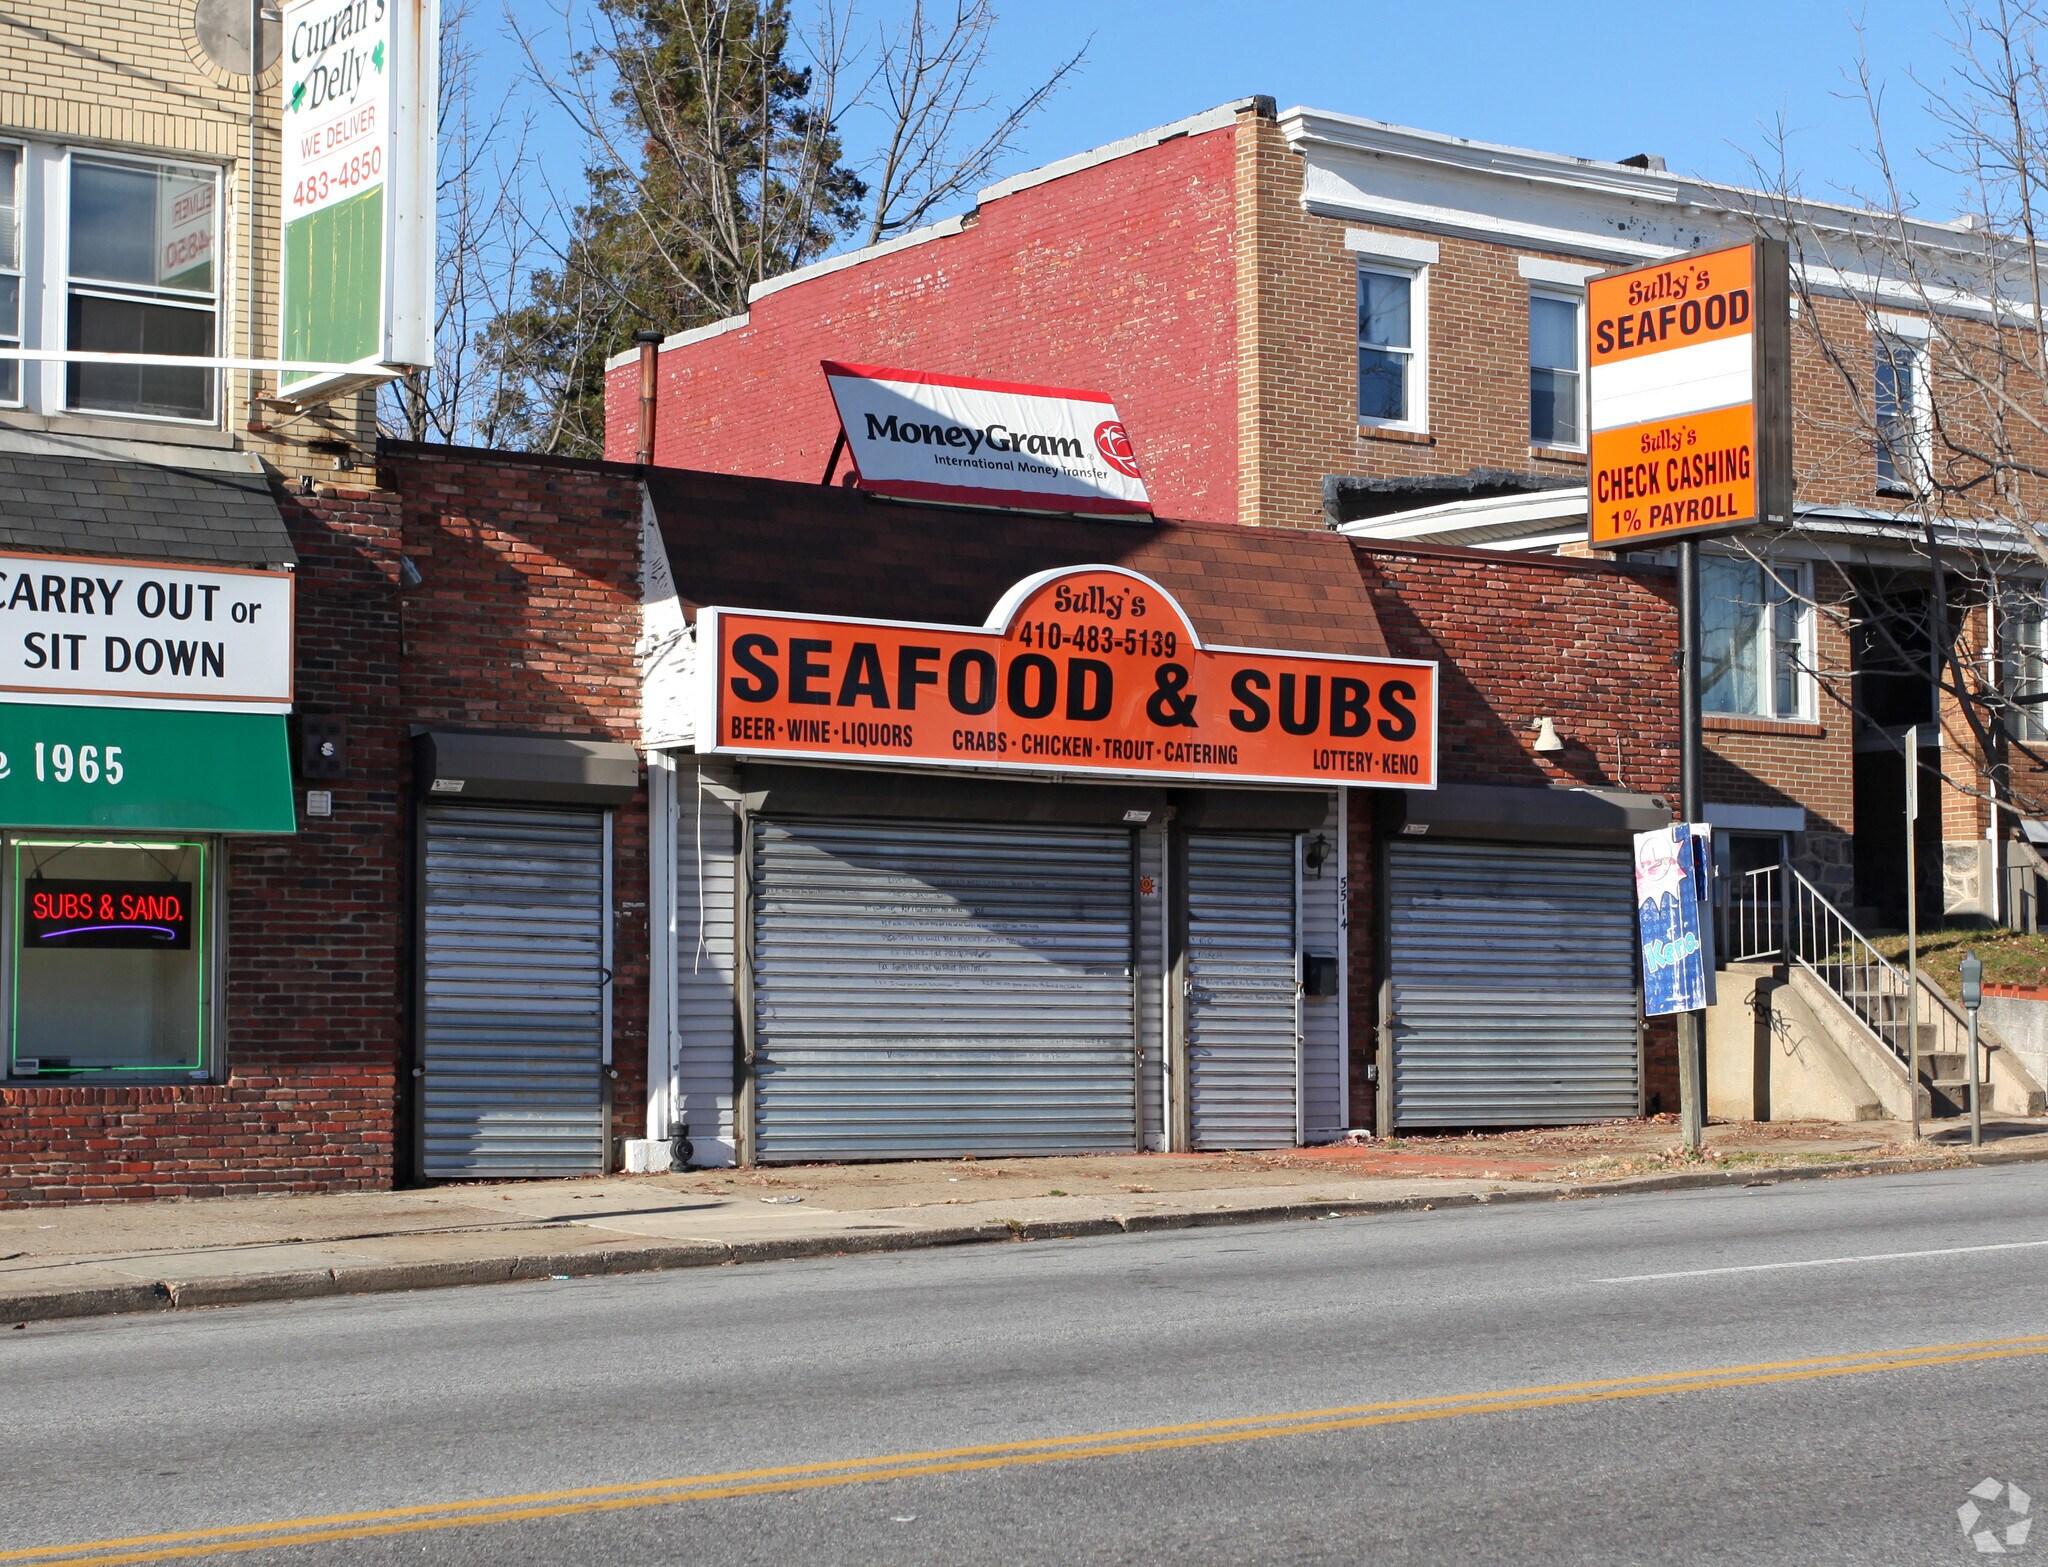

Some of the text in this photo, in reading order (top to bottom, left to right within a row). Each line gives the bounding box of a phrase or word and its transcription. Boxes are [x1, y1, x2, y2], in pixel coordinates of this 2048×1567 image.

[291, 0, 385, 64] Currans
[310, 45, 368, 110] Delly
[301, 105, 375, 159] WE DELIVER
[293, 145, 382, 207] 483-4850
[1628, 265, 1710, 306] Sully's
[1596, 289, 1749, 354] SEAFOOD
[864, 413, 1084, 458] MoneyGram
[1640, 425, 1697, 453] Sully's
[934, 454, 1108, 479] International Money Transfer
[1597, 445, 1750, 503] CHECK CASHING
[1611, 493, 1737, 534] 1% PAYROLL
[0, 572, 261, 624] ARRY OUT or
[1054, 584, 1146, 620] Sully's
[24, 632, 224, 678] SIT DOWN
[1019, 621, 1177, 658] 410-483-5139
[731, 633, 1417, 742] SEAFOOD & SUBS
[731, 716, 913, 748] BEER WINE LIQUORS
[952, 729, 1238, 765] CRABS CHICKEN TROUT CATERING
[35, 742, 124, 785] 1965
[1313, 749, 1418, 775] LOTTERY KENO
[33, 893, 93, 919] SUBS
[100, 894, 114, 920] &
[1340, 876, 1348, 931] 5514
